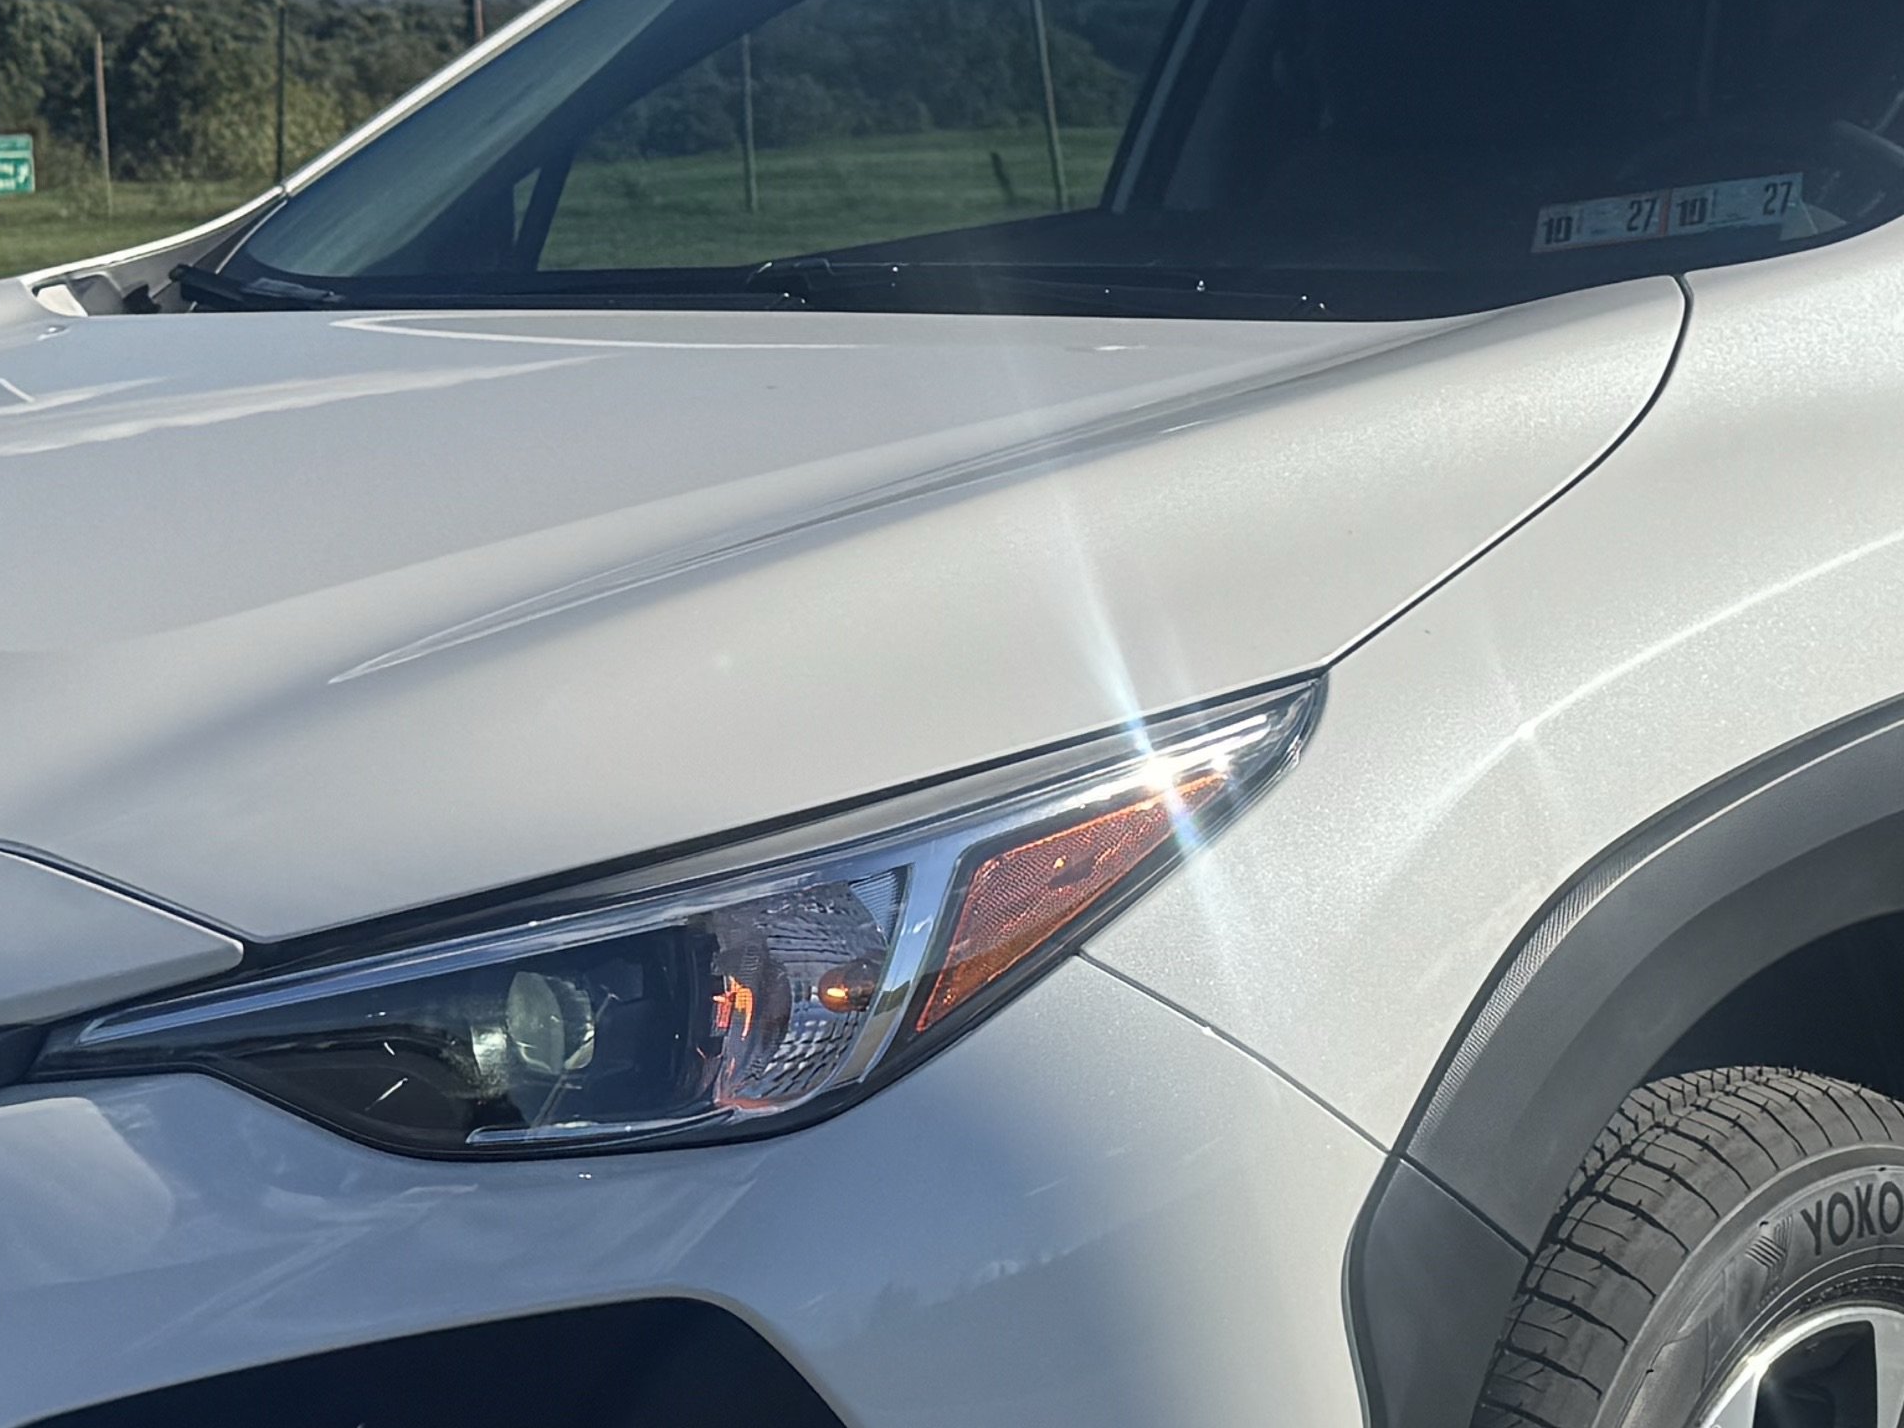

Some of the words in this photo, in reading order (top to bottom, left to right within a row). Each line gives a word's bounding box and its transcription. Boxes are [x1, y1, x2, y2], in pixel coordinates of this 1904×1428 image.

[1542, 216, 1573, 245] 10
[1626, 198, 1659, 232] 27
[1677, 197, 1708, 226] 10
[1763, 181, 1793, 215] 27
